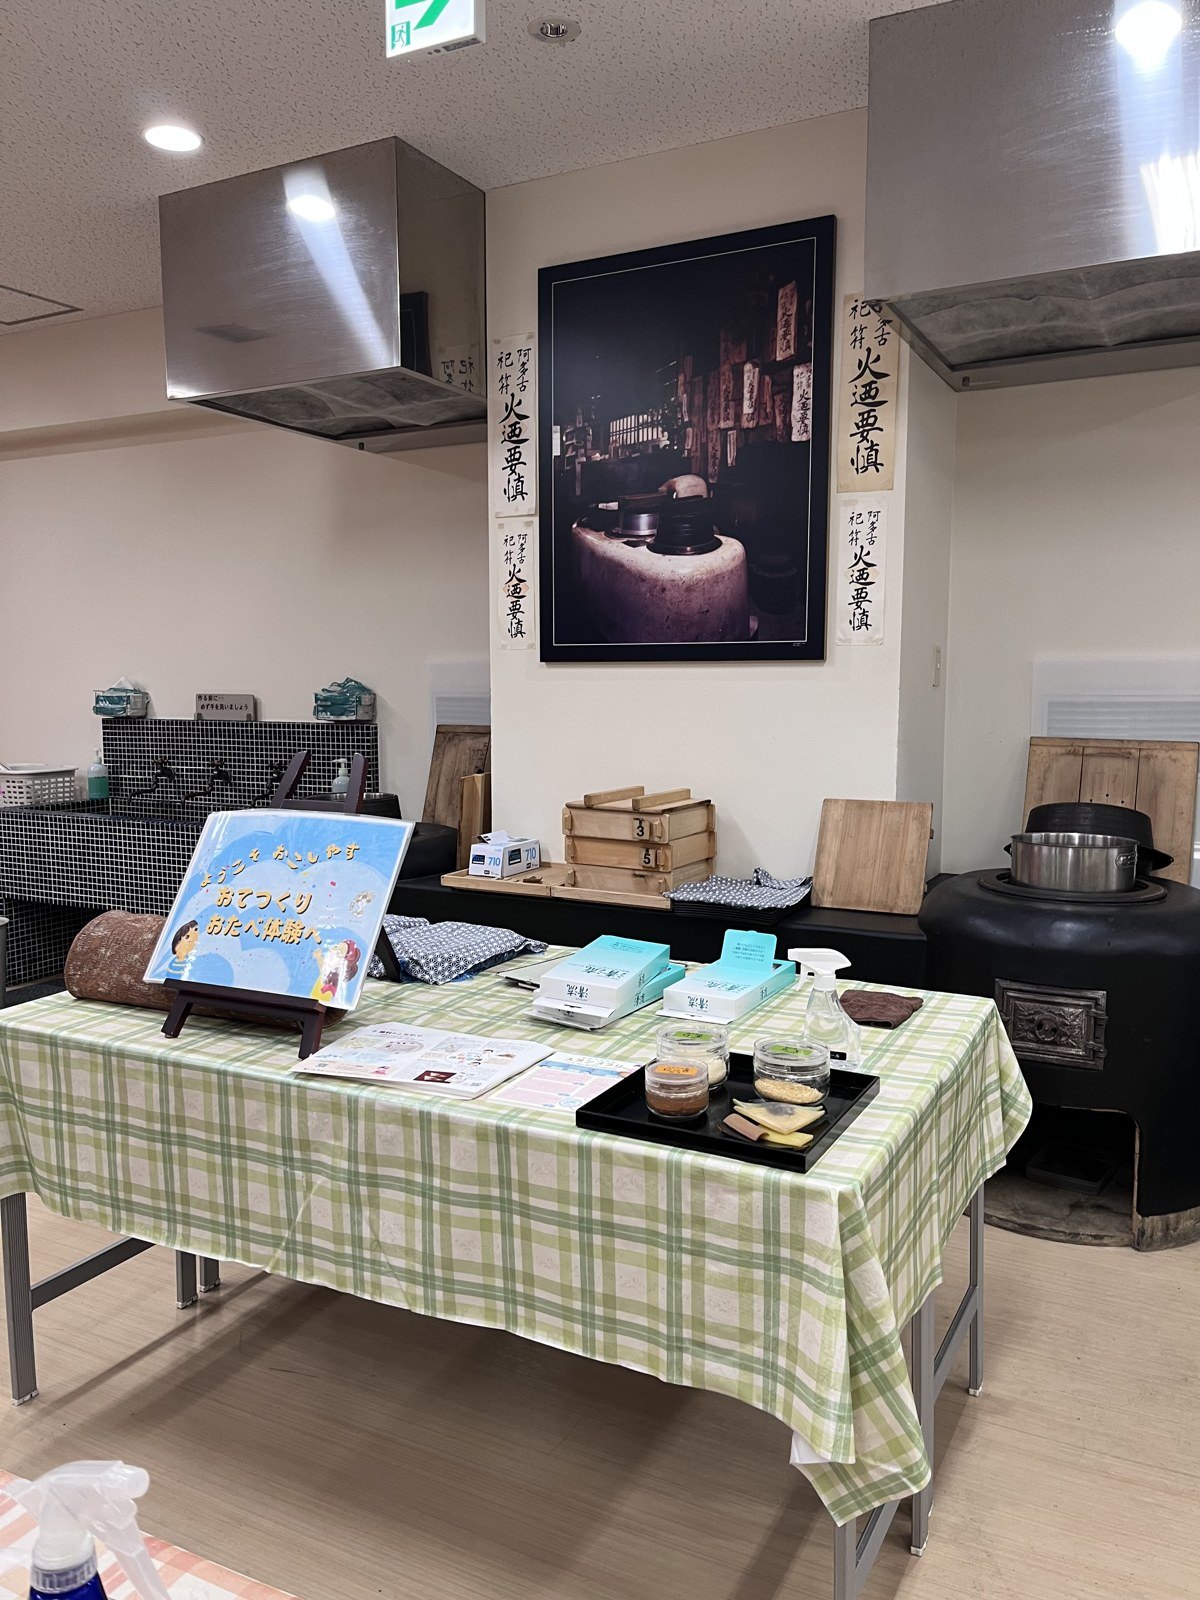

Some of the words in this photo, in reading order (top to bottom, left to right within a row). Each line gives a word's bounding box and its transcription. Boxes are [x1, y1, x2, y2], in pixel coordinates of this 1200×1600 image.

[487, 857, 501, 867] 710
[525, 847, 537, 861] 710
[201, 848, 260, 888] ようこそ
[215, 886, 313, 915] おてつくり
[205, 913, 323, 946] おたべ体験へ
[566, 983, 589, 999] 清流
